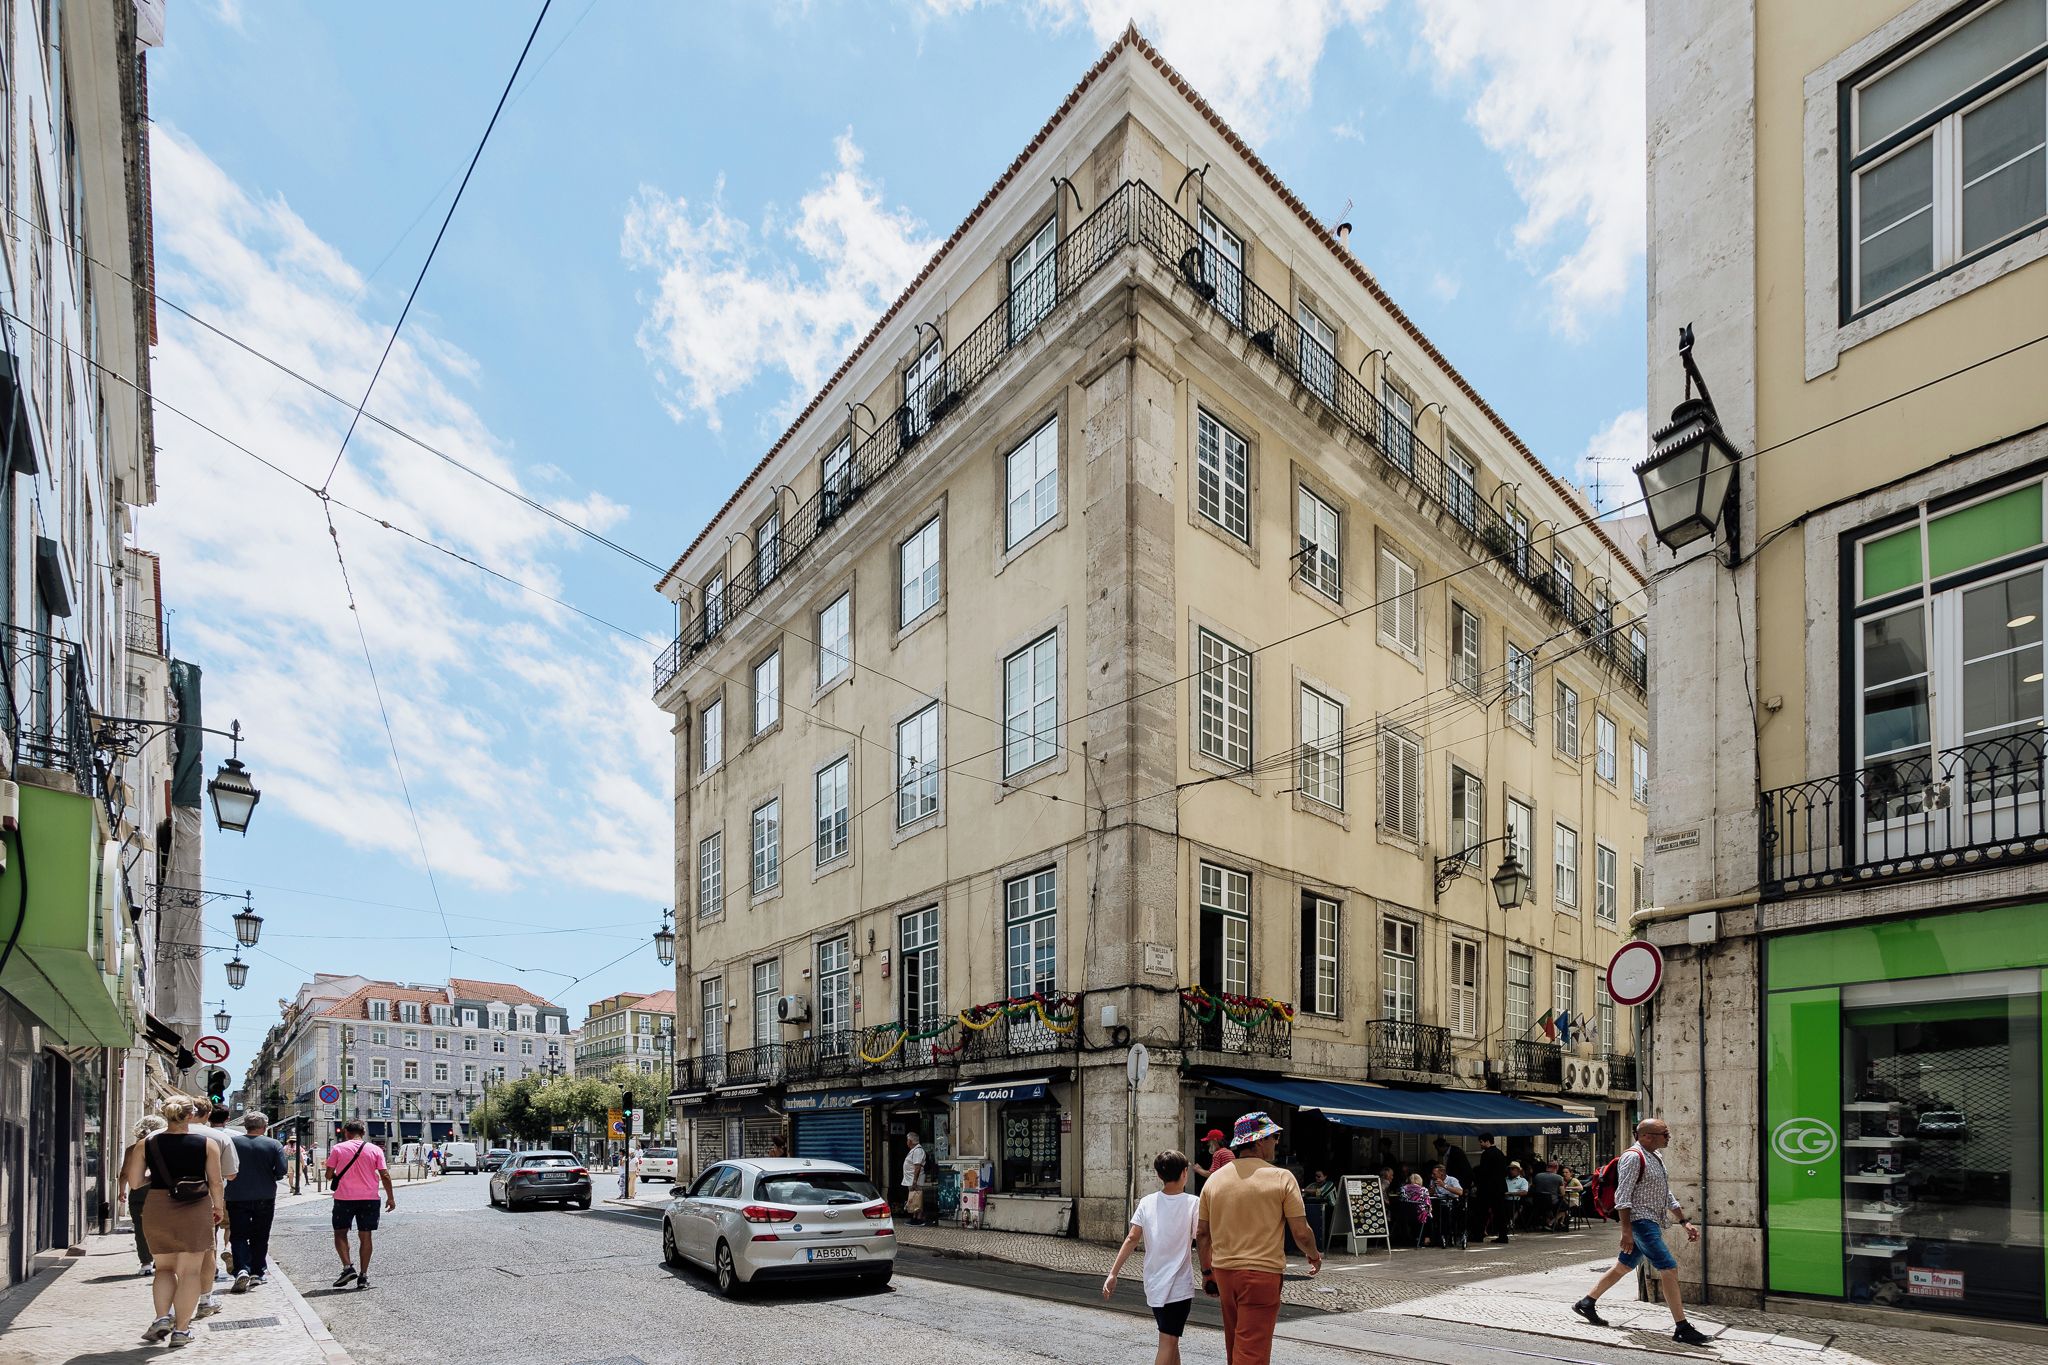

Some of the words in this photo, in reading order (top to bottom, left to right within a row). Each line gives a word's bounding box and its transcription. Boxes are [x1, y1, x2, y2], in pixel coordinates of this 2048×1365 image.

[383, 1084, 390, 1107] P
[738, 1088, 759, 1096] PASSADO
[1542, 1126, 1562, 1134] Pastelaria
[1575, 1122, 1586, 1133] JOÃO
[1778, 1128, 1831, 1154] CG
